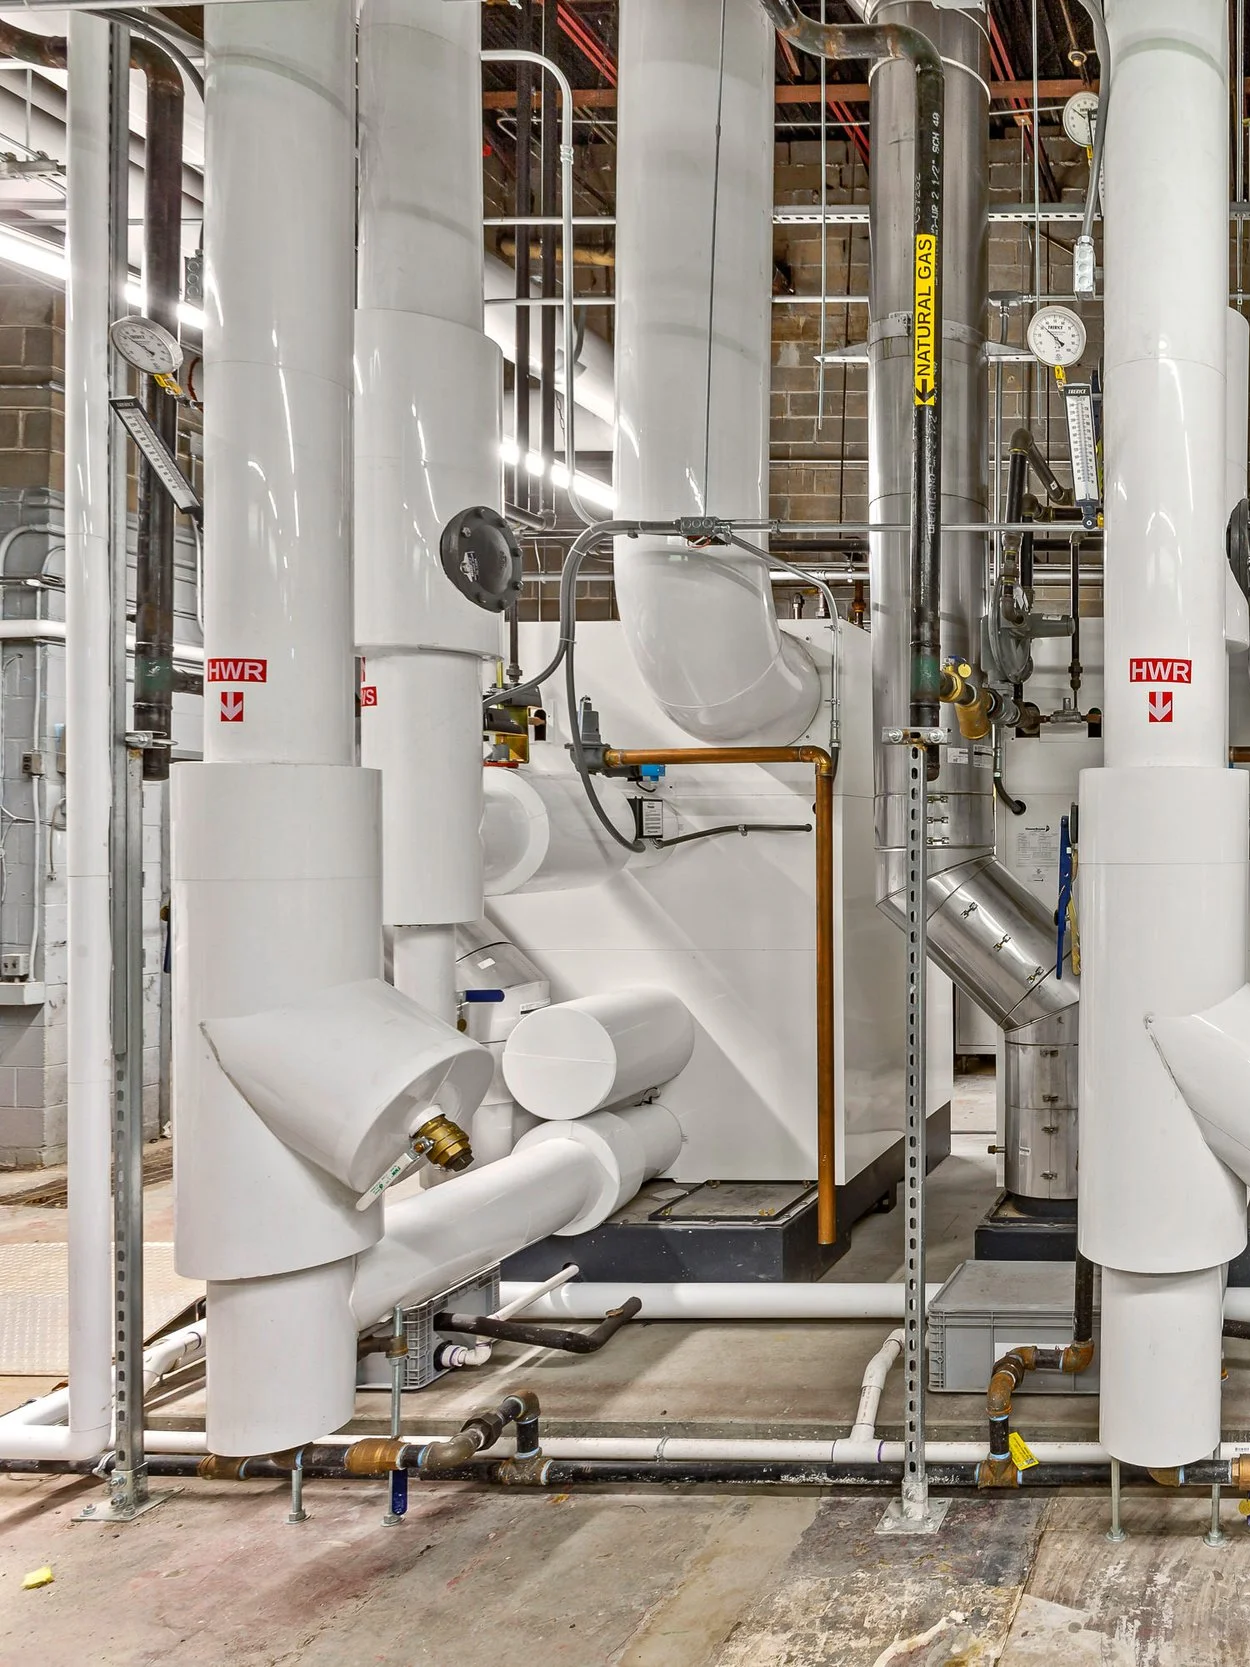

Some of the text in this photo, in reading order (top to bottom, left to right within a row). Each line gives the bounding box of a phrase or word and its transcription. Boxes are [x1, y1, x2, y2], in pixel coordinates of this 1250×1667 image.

[917, 238, 933, 376] NATURAL GAS
[208, 660, 264, 682] HWR
[1131, 661, 1190, 682] HWR
